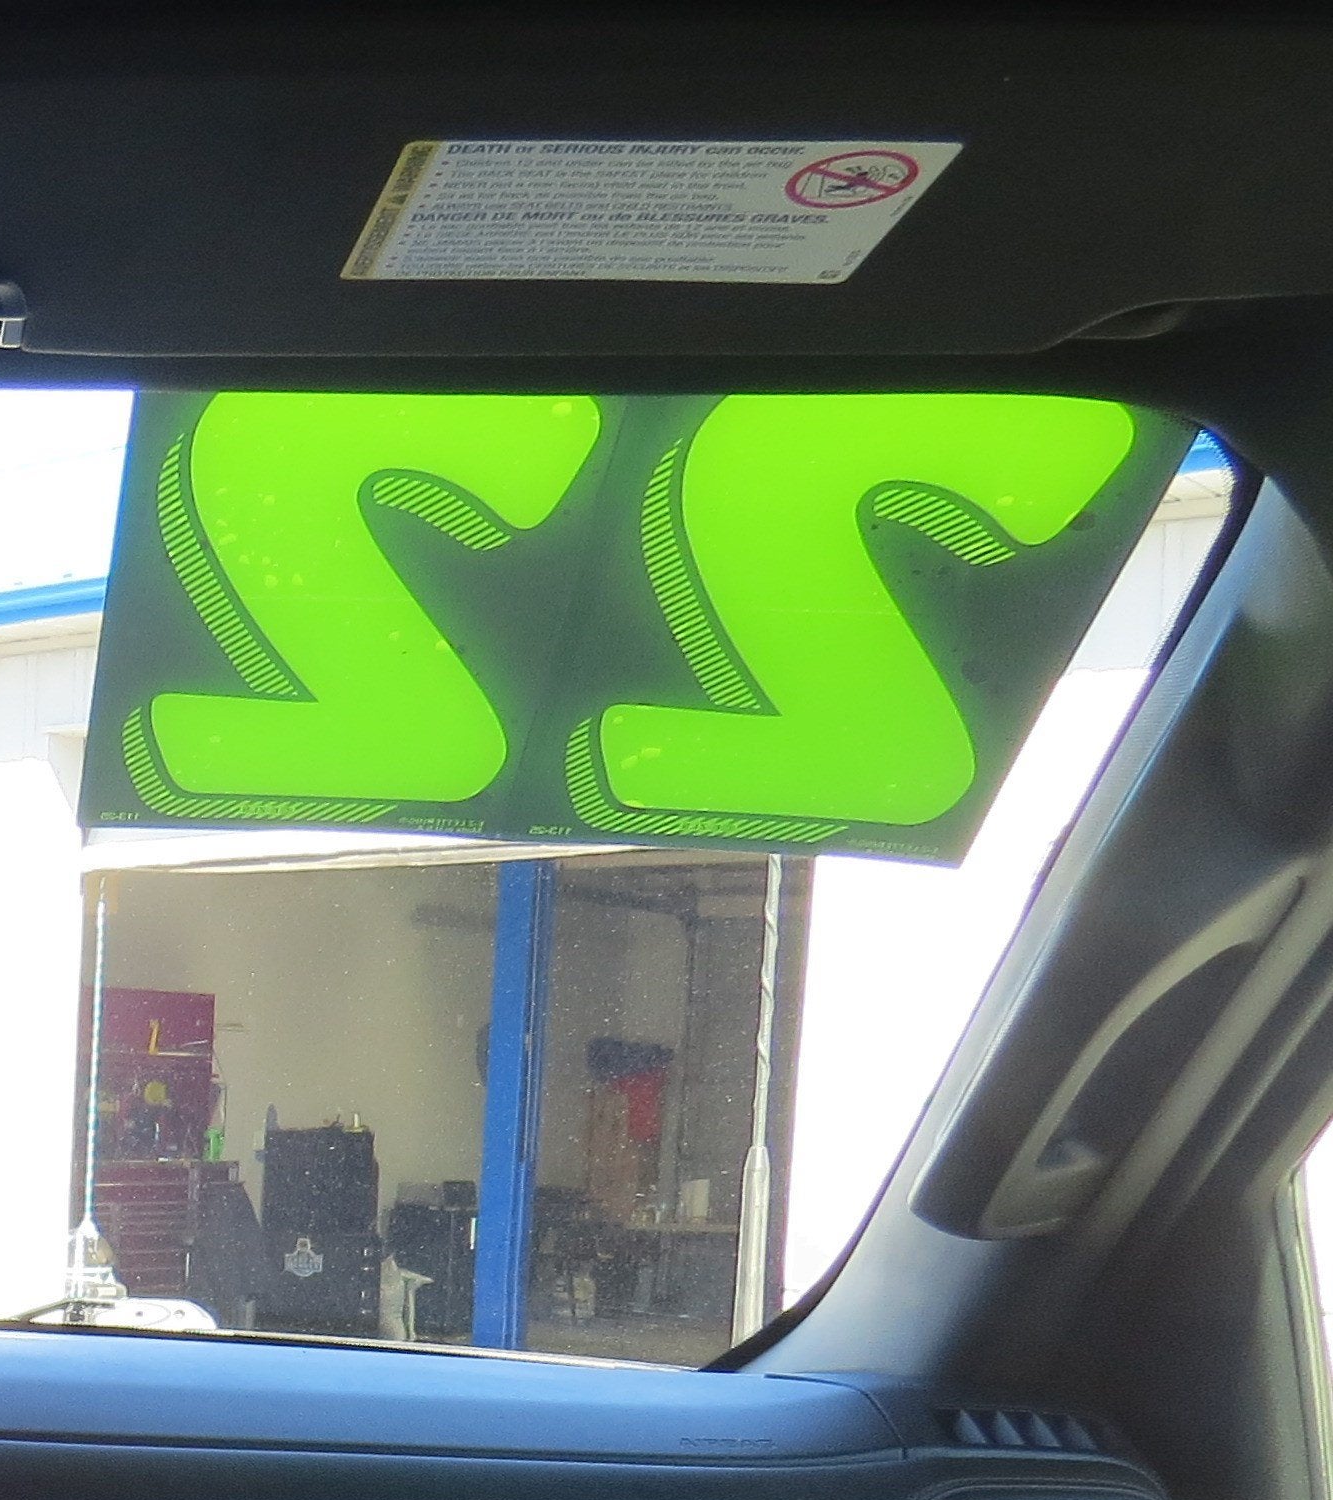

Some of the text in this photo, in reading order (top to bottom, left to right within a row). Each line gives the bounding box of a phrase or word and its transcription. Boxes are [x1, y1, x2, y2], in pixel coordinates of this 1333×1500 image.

[446, 143, 511, 155] DEATH
[516, 146, 534, 155] or
[539, 143, 625, 155] SERIOUS
[628, 144, 704, 155] INJURY
[706, 146, 742, 155] can
[411, 212, 488, 222] DANGER
[491, 212, 513, 222] DE
[520, 212, 578, 222] MORT
[579, 214, 604, 222] ou
[608, 213, 632, 223] de
[636, 213, 746, 223] BLESSURES
